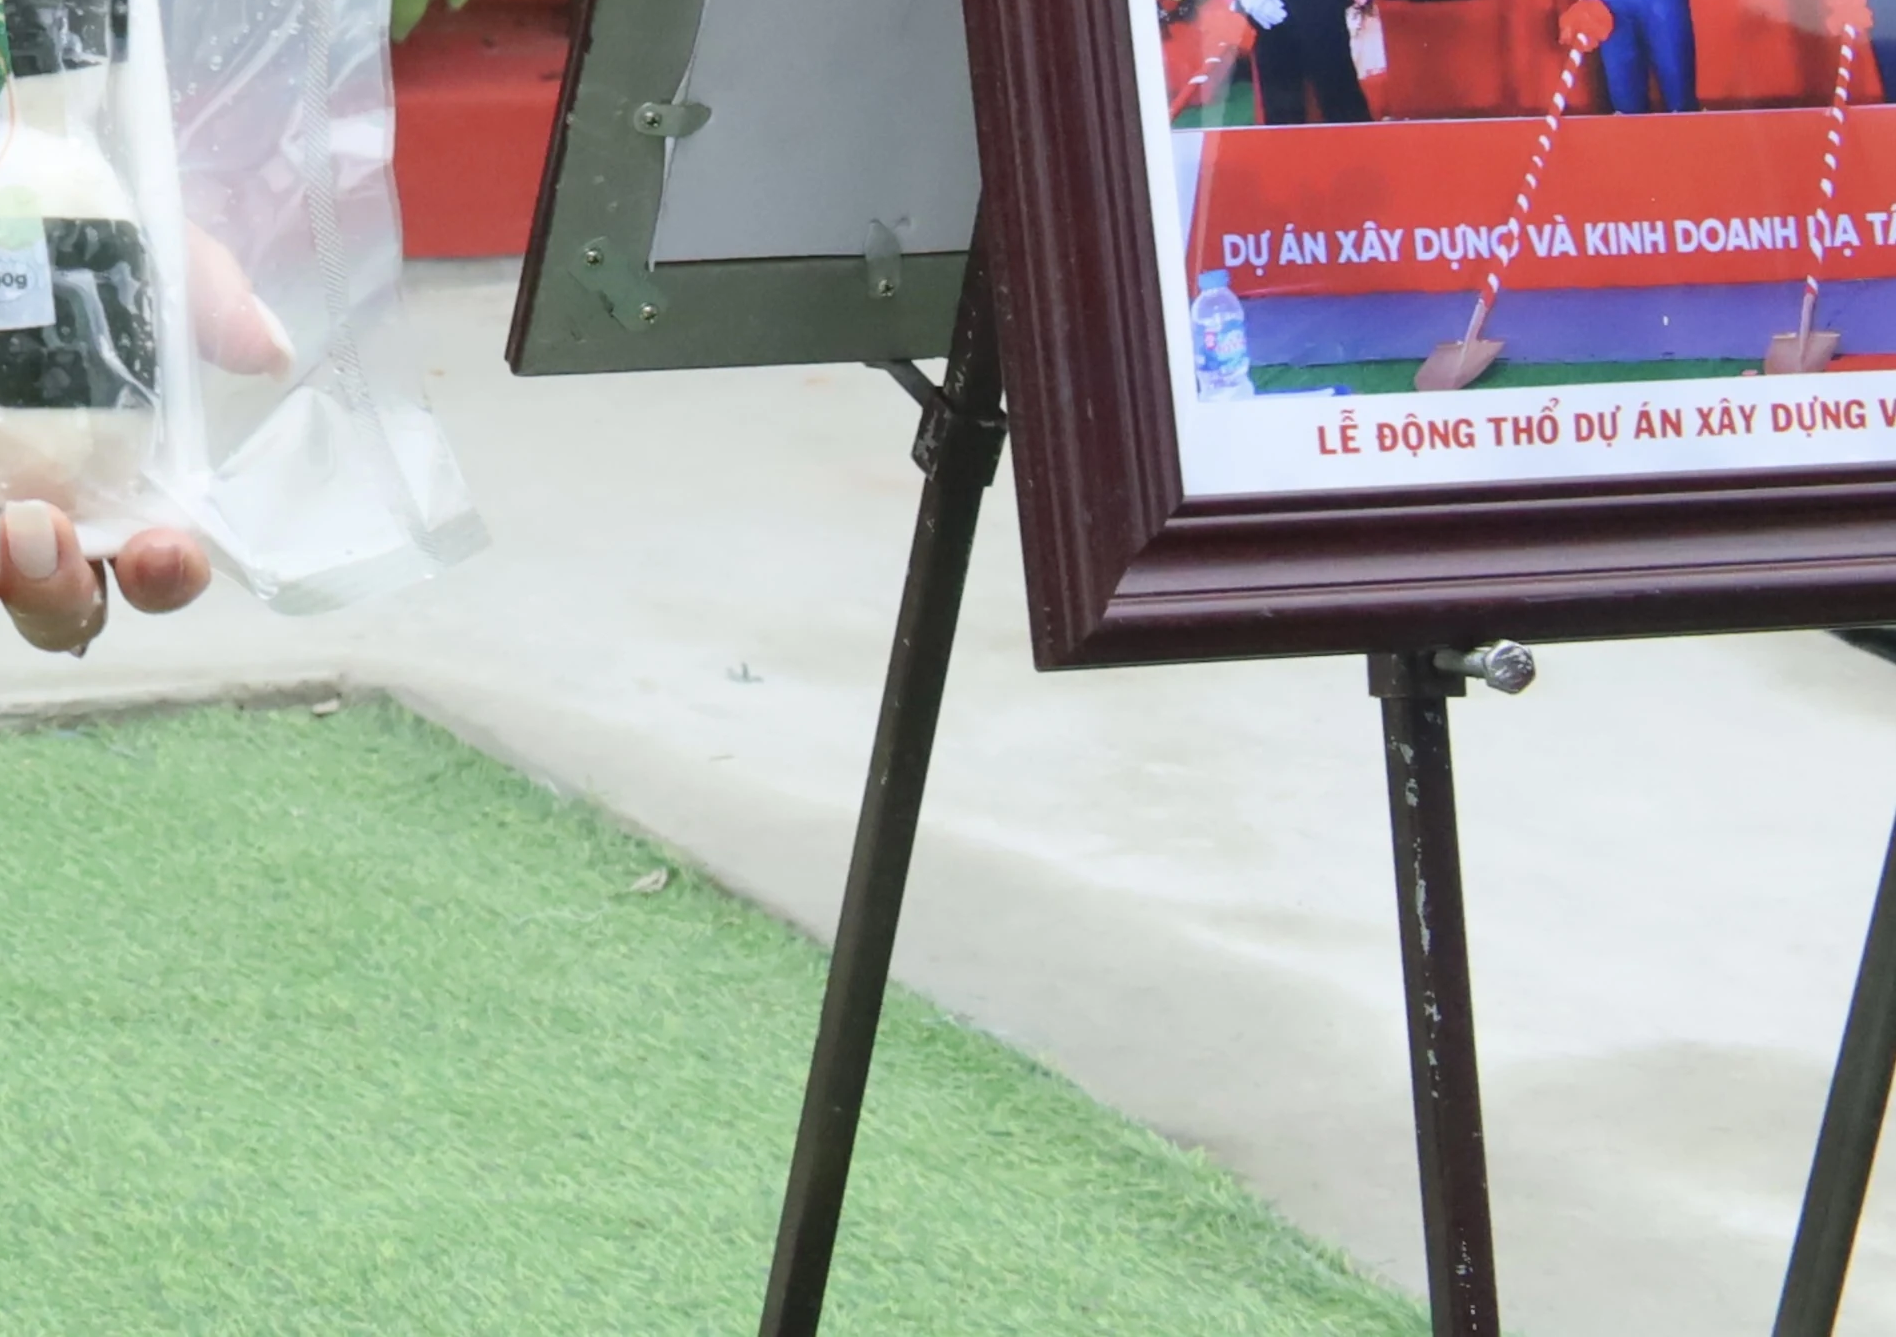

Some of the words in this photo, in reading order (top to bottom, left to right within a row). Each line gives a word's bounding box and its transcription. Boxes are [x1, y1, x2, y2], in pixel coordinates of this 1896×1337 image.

[1222, 229, 1271, 277] DỰ
[1278, 224, 1327, 265] ÁN
[1335, 220, 1404, 264] XÂY
[1526, 214, 1578, 258] VÀ
[1584, 220, 1667, 256] KINH
[1674, 215, 1798, 253] DOANH
[1317, 408, 1361, 457] LỄ
[1375, 412, 1476, 457] ĐỘNG
[1486, 396, 1561, 448] THỔ
[1573, 405, 1621, 448] DỰ
[1633, 401, 1684, 441] ÁN
[1696, 397, 1757, 437] XÂY
[1770, 395, 1867, 438] DỰNG
